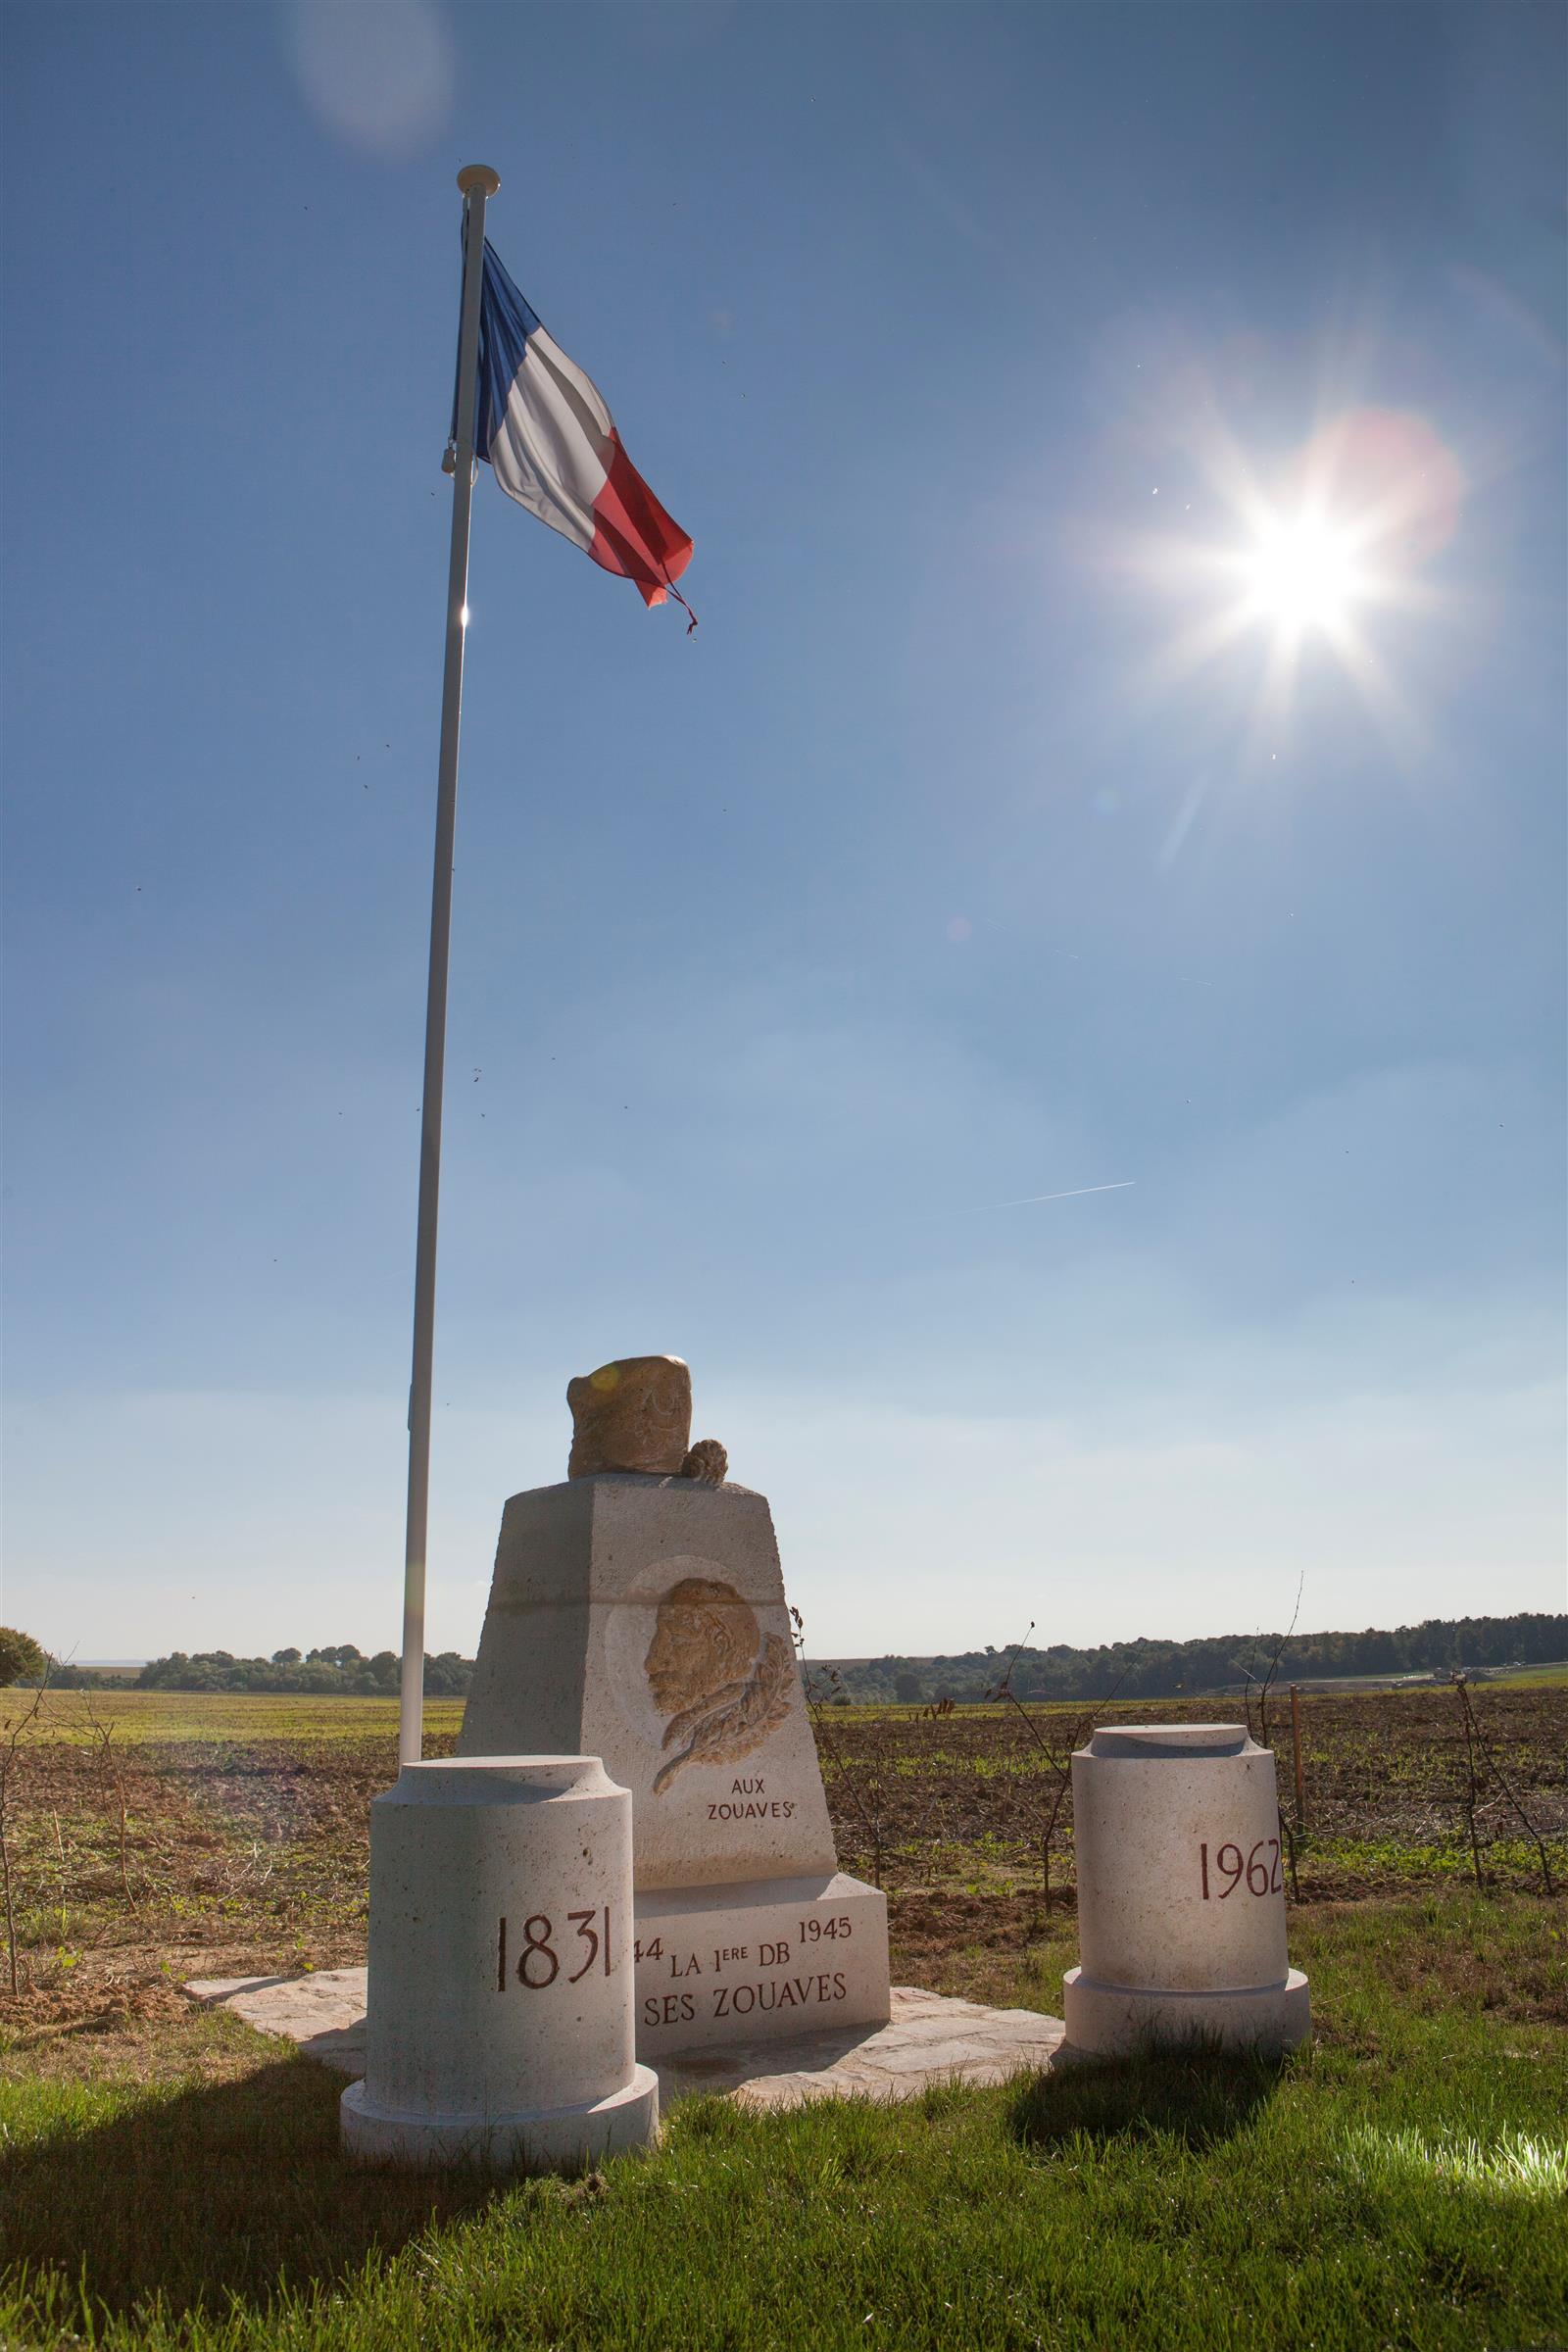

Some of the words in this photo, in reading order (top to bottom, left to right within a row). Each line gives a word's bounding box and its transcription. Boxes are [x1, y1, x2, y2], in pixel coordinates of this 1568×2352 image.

[708, 1801, 792, 1820] ZOUAVES
[731, 1779, 764, 1794] AUX
[1200, 1838, 1282, 1899] 1962
[497, 1906, 611, 1991] 1831
[670, 1952, 702, 1978] LA
[759, 1941, 791, 1967] DB
[799, 1916, 853, 1943] 1945
[644, 1993, 695, 2027] SES
[712, 1972, 847, 2019] ZOUAVES
